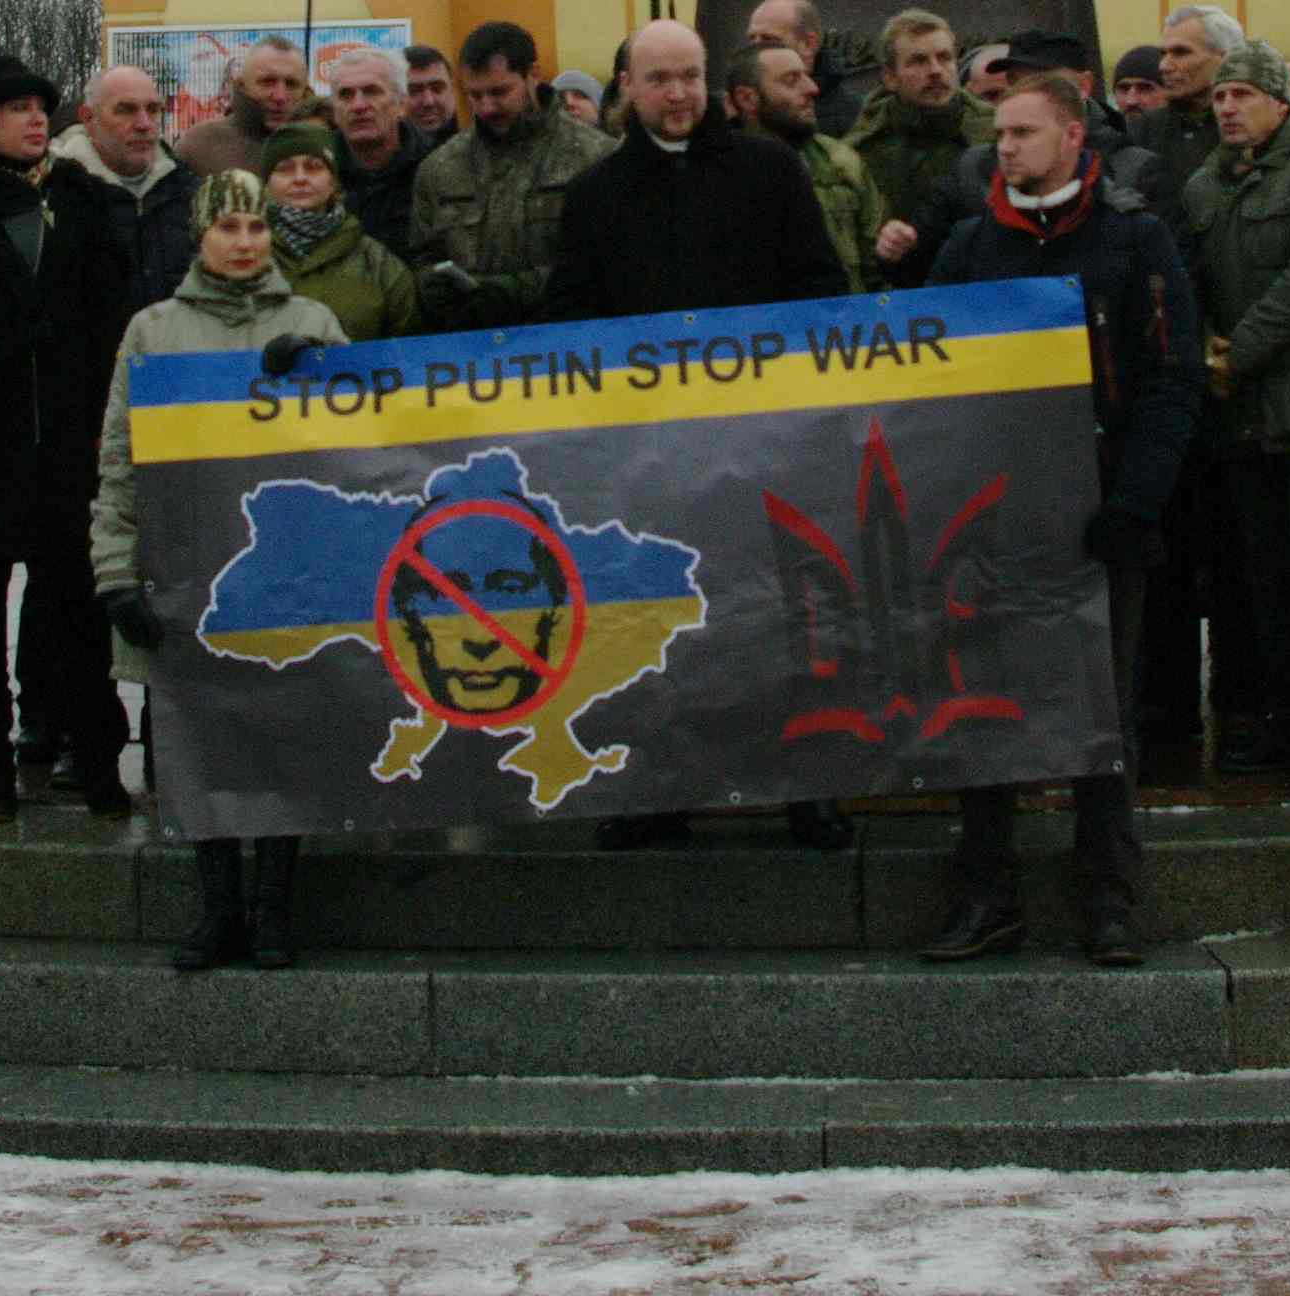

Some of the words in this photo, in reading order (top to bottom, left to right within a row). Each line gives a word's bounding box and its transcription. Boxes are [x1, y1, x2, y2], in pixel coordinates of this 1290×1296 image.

[247, 366, 405, 422] STOP
[425, 346, 602, 409] PUTIN
[626, 331, 786, 390] STOP
[805, 316, 951, 374] WAR
